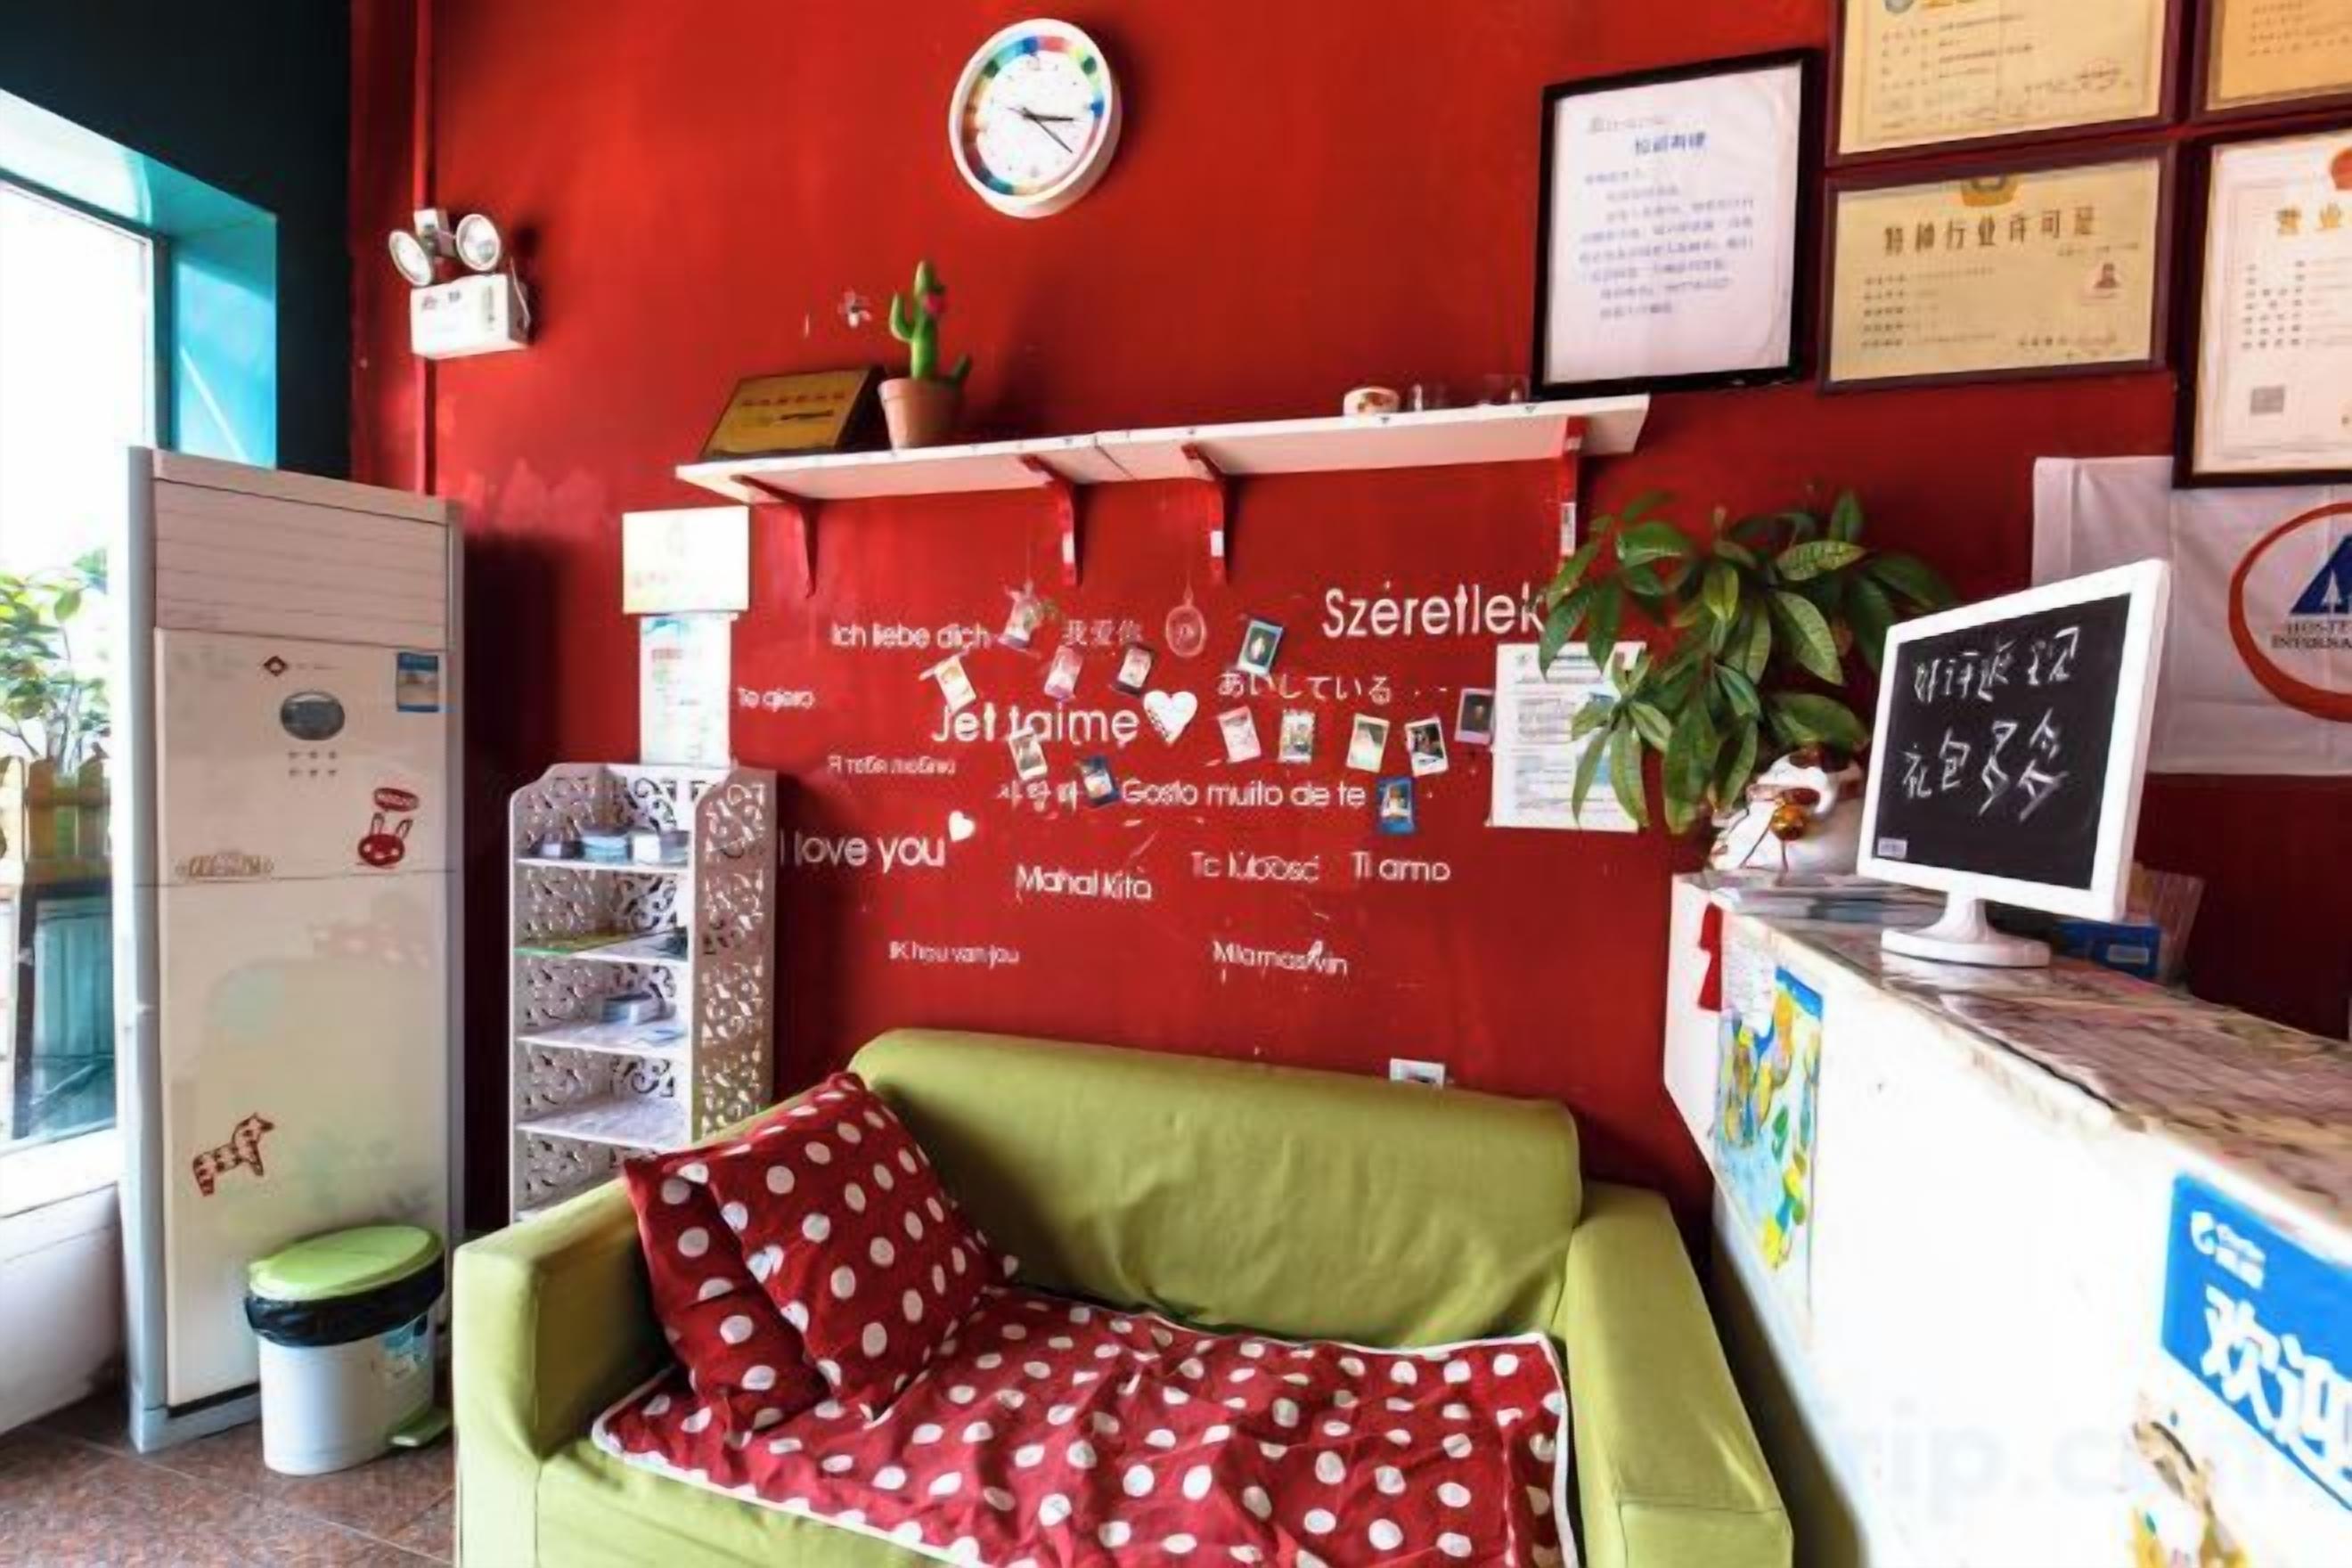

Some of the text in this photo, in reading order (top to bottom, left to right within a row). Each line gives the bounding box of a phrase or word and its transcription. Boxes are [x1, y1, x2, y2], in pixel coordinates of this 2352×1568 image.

[830, 622, 990, 649] Ich liebe dich
[1122, 778, 1198, 807] Gosto
[1291, 780, 1332, 806] de
[1337, 780, 1366, 807] te
[795, 830, 868, 866] love
[878, 835, 945, 874] you
[1016, 864, 1098, 898] Mahal
[1379, 858, 1451, 882] amo
